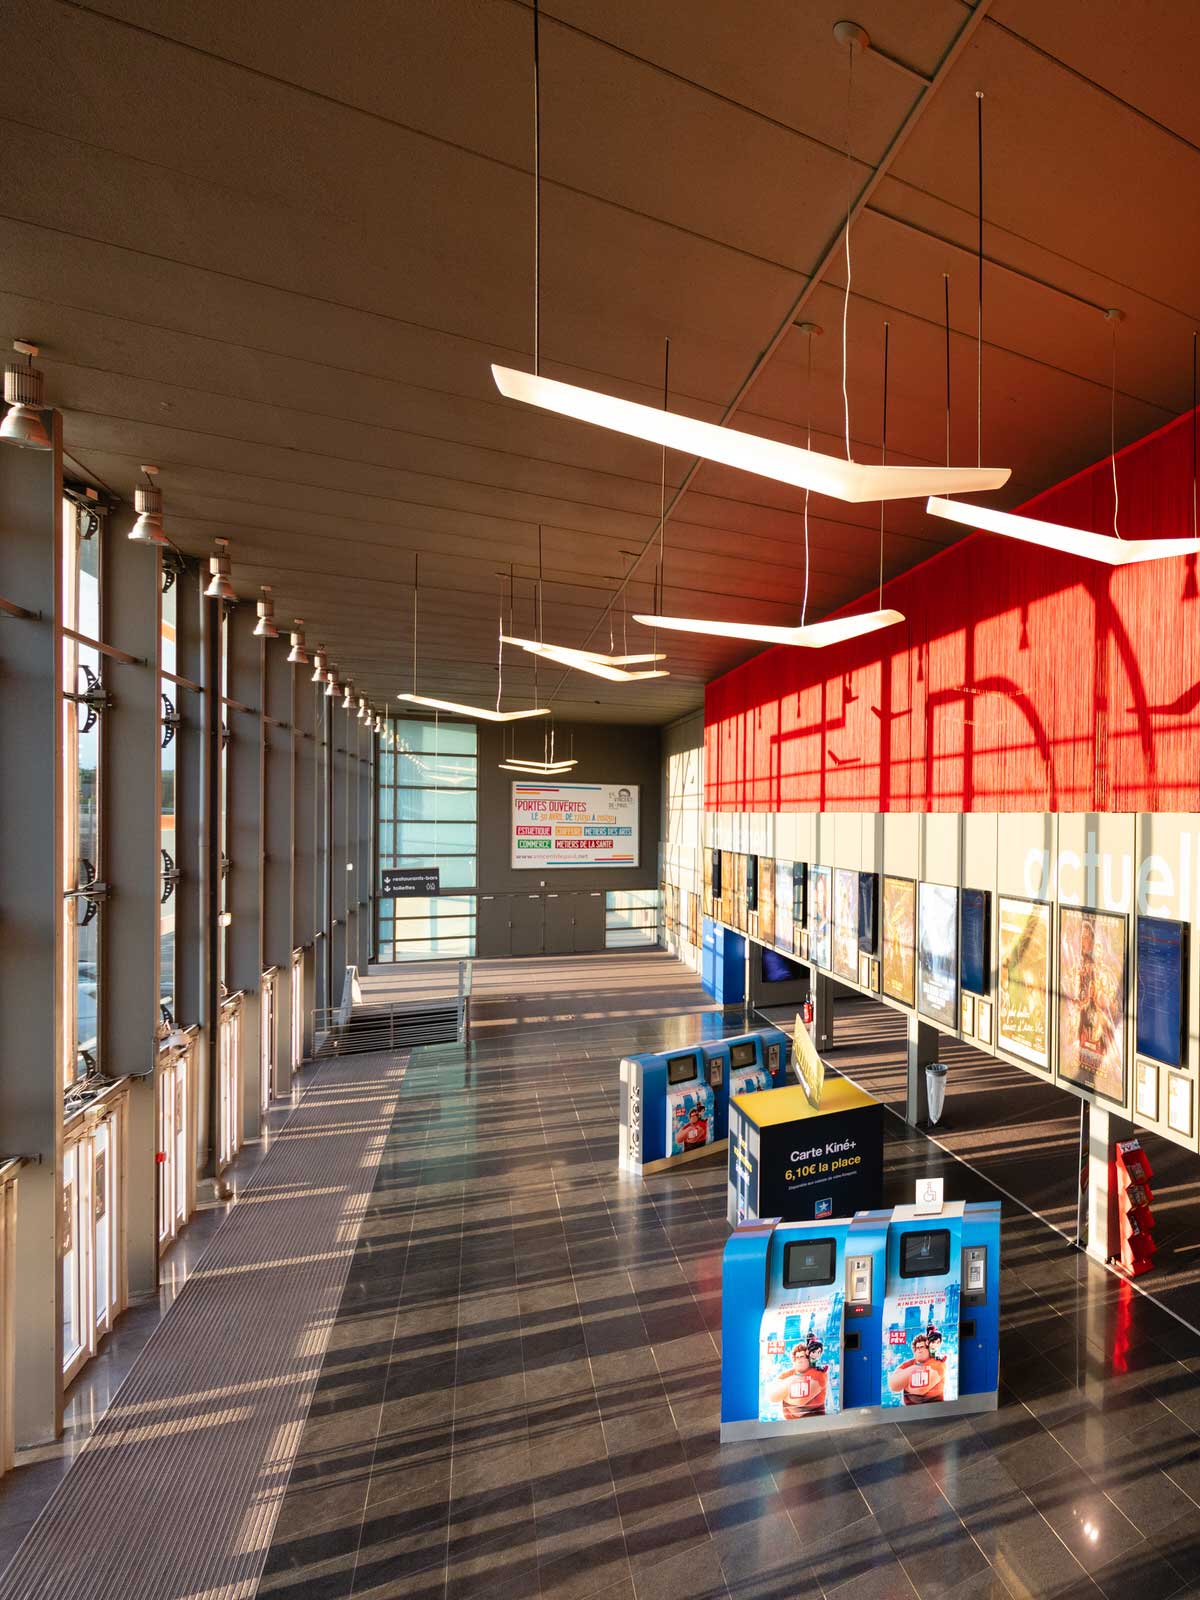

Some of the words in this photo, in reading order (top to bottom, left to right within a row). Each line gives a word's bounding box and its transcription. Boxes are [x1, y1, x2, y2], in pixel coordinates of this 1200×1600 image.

[517, 800, 547, 812] PORTES
[549, 802, 587, 812] OUVERTES
[790, 1147, 823, 1162] Carte
[825, 1139, 856, 1154] Kiné+
[785, 1164, 816, 1181] 6,10€
[819, 1162, 828, 1173] la
[832, 1156, 861, 1171] place
